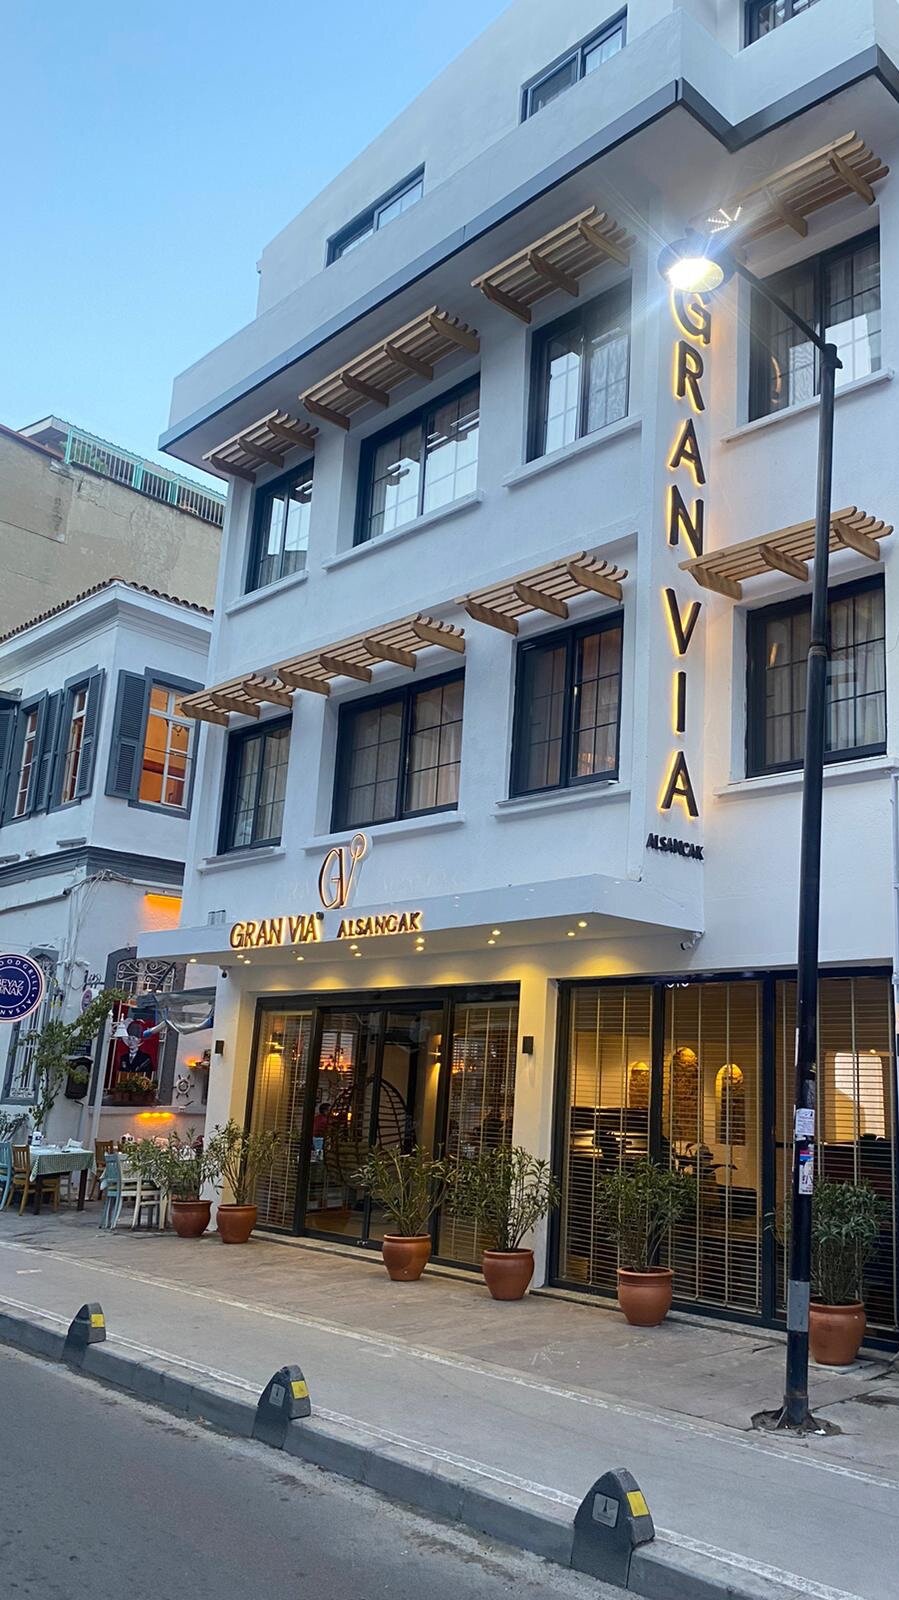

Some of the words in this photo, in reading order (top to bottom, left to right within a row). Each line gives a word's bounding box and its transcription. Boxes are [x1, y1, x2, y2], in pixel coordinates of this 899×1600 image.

[668, 288, 711, 559] GRAN
[660, 588, 702, 817] VIA
[646, 832, 704, 860] ALSANCAK
[230, 917, 283, 949] GRAN
[288, 912, 318, 943] VIA
[336, 911, 421, 938] ALSANCAK
